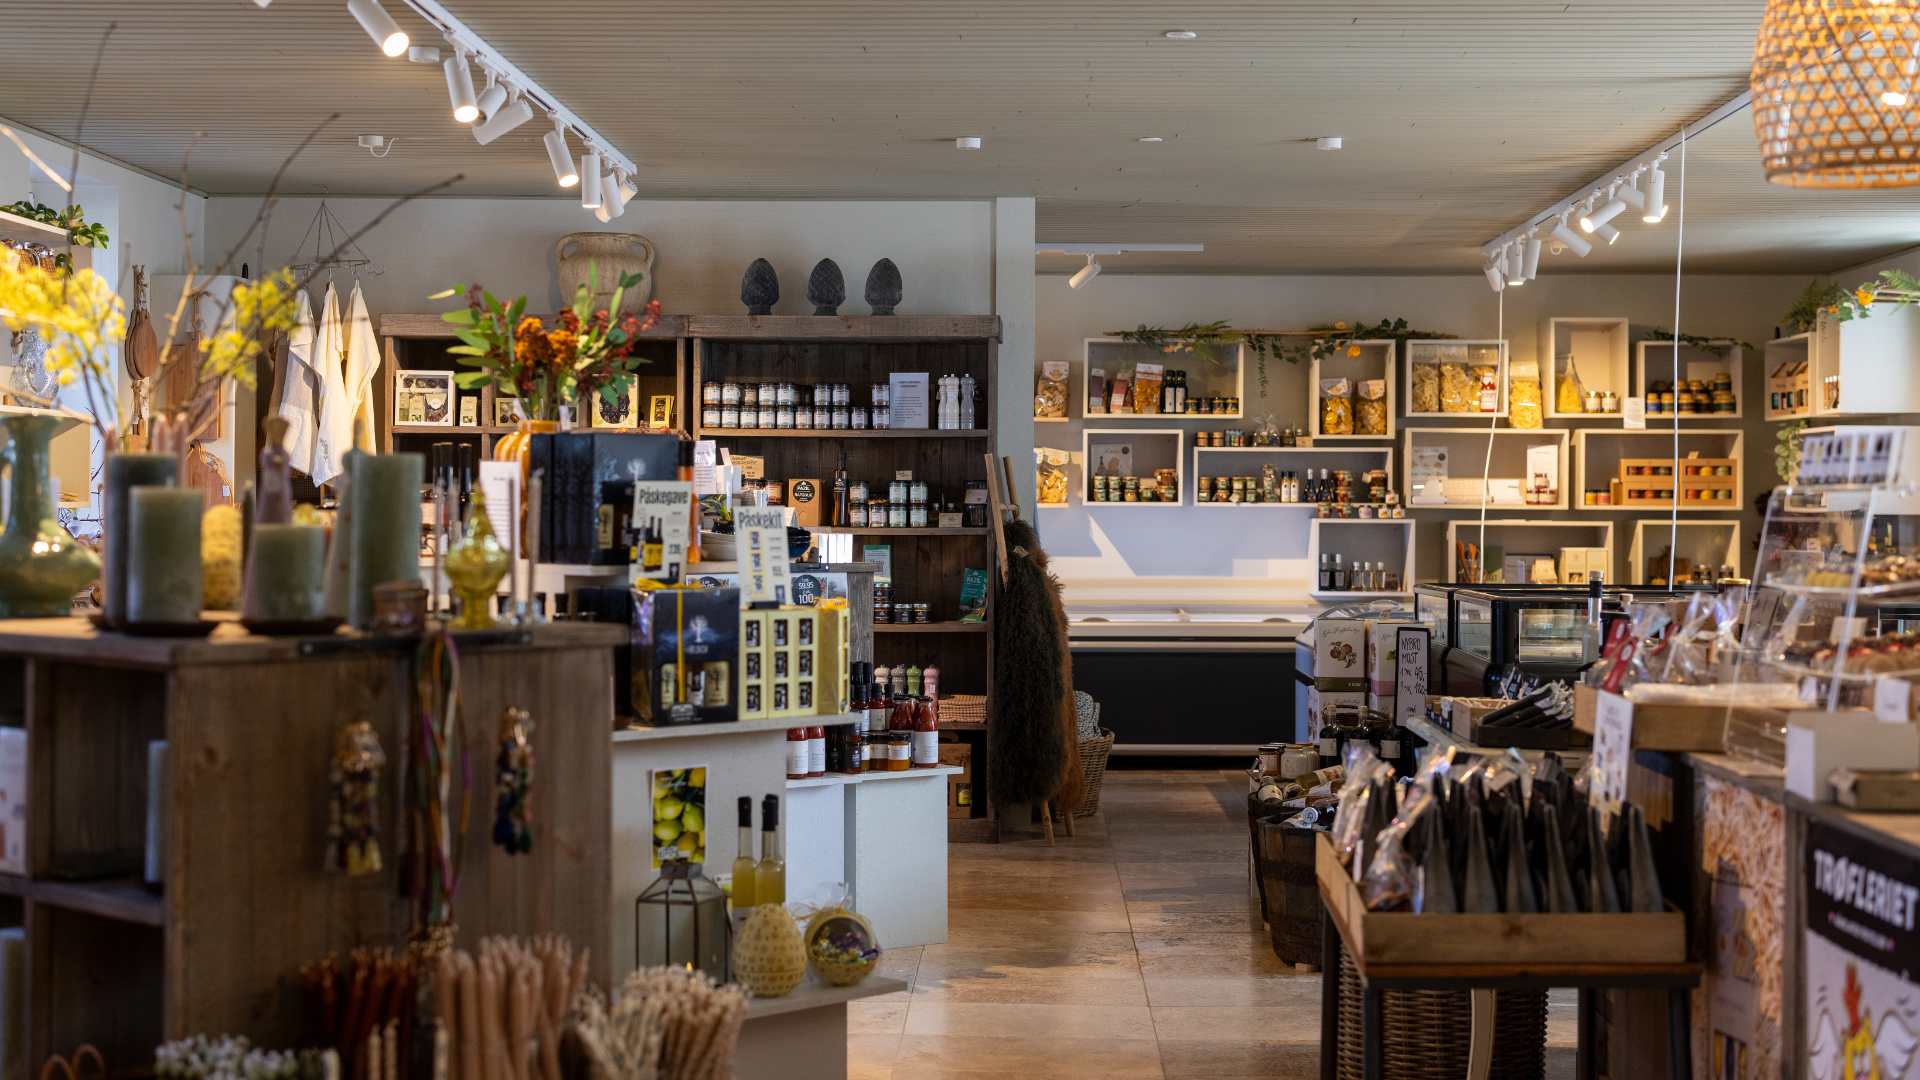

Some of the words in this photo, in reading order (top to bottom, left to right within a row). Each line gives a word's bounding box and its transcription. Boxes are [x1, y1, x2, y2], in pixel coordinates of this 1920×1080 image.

[639, 486, 688, 505] Påskegave
[739, 509, 782, 529] Påskekit
[1401, 637, 1421, 652] NYBRO
[1401, 652, 1418, 665] MOST
[1813, 848, 1920, 932] TRØFLERIET
